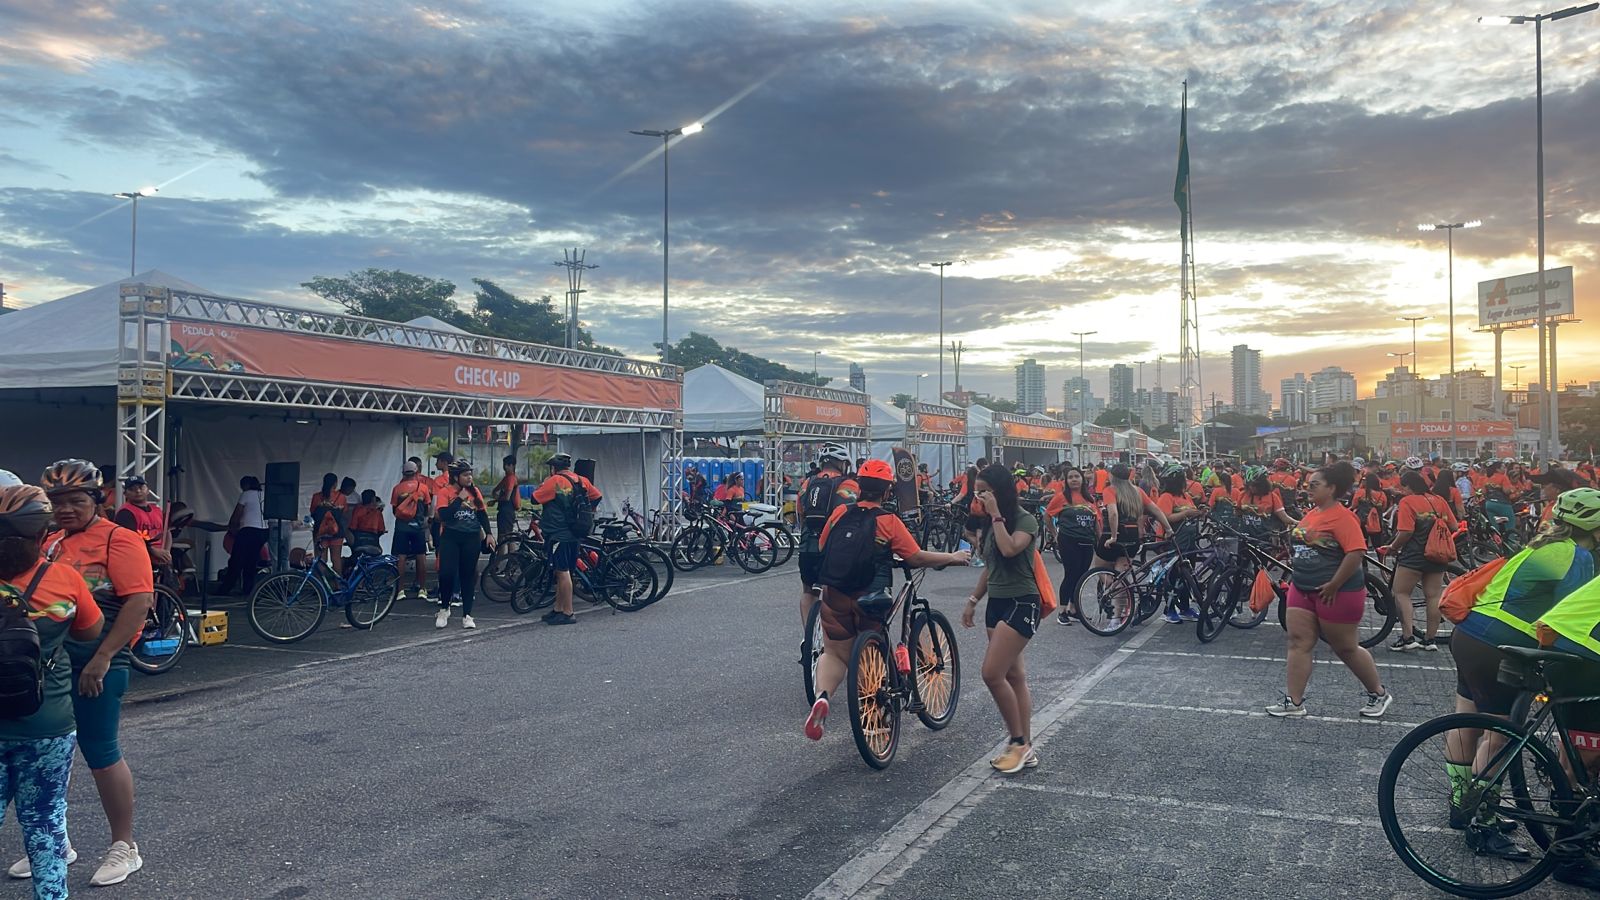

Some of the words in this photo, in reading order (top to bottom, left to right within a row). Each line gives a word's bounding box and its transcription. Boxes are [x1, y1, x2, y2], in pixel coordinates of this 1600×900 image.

[1508, 279, 1560, 296] ATACAÃO
[182, 324, 215, 337] PEDALA
[454, 365, 521, 390] CHECK-UP
[1420, 423, 1453, 433] PEDALA
